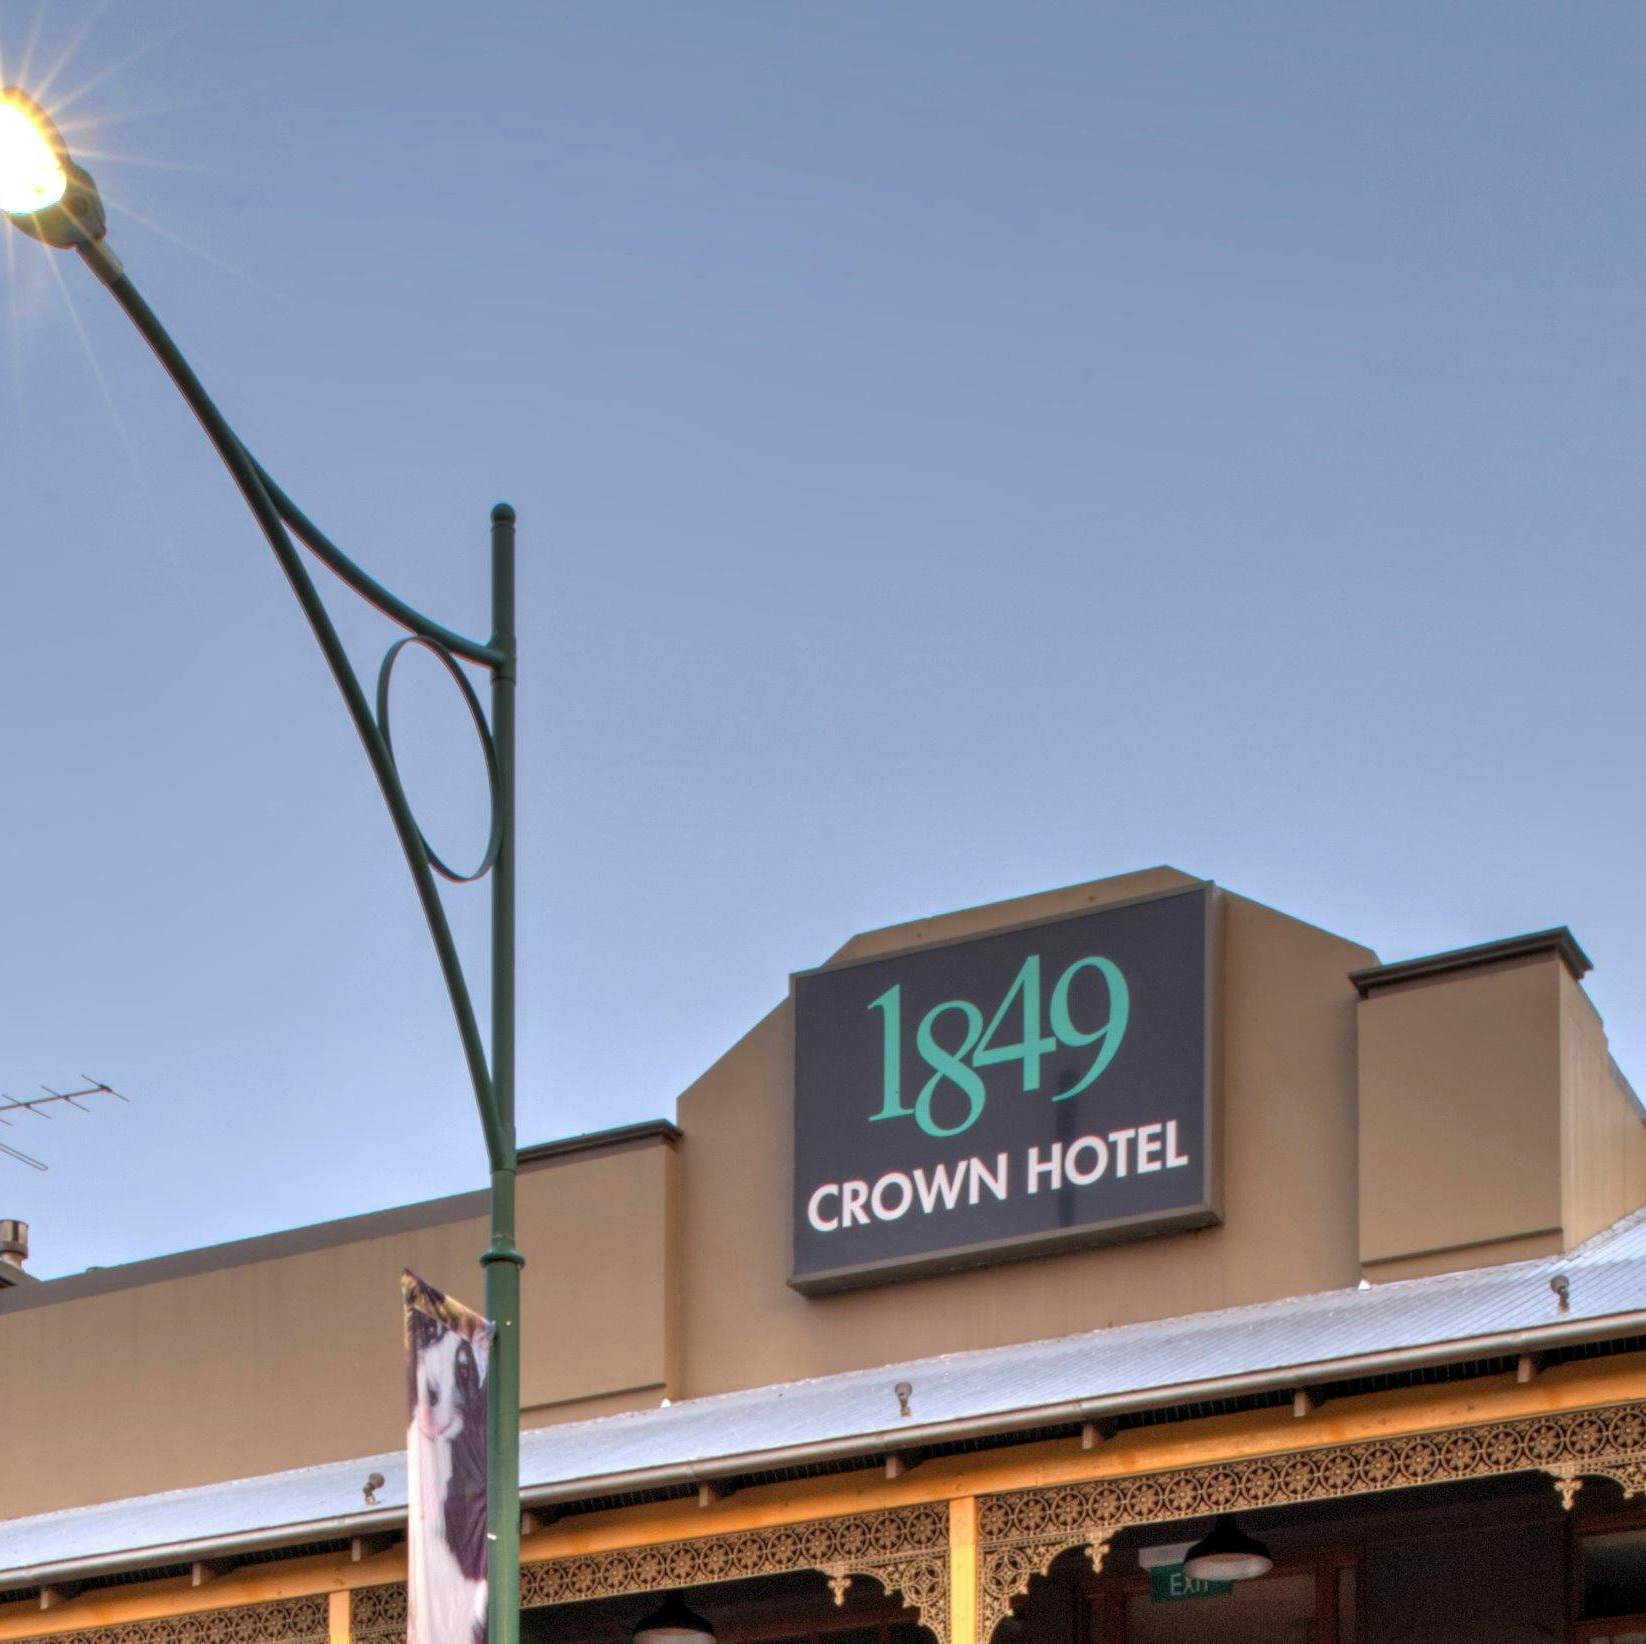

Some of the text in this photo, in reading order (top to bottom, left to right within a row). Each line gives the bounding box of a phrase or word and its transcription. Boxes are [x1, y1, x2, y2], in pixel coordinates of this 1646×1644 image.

[868, 954, 1129, 1137] 1849
[807, 1120, 1189, 1232] CROWN HOTEL
